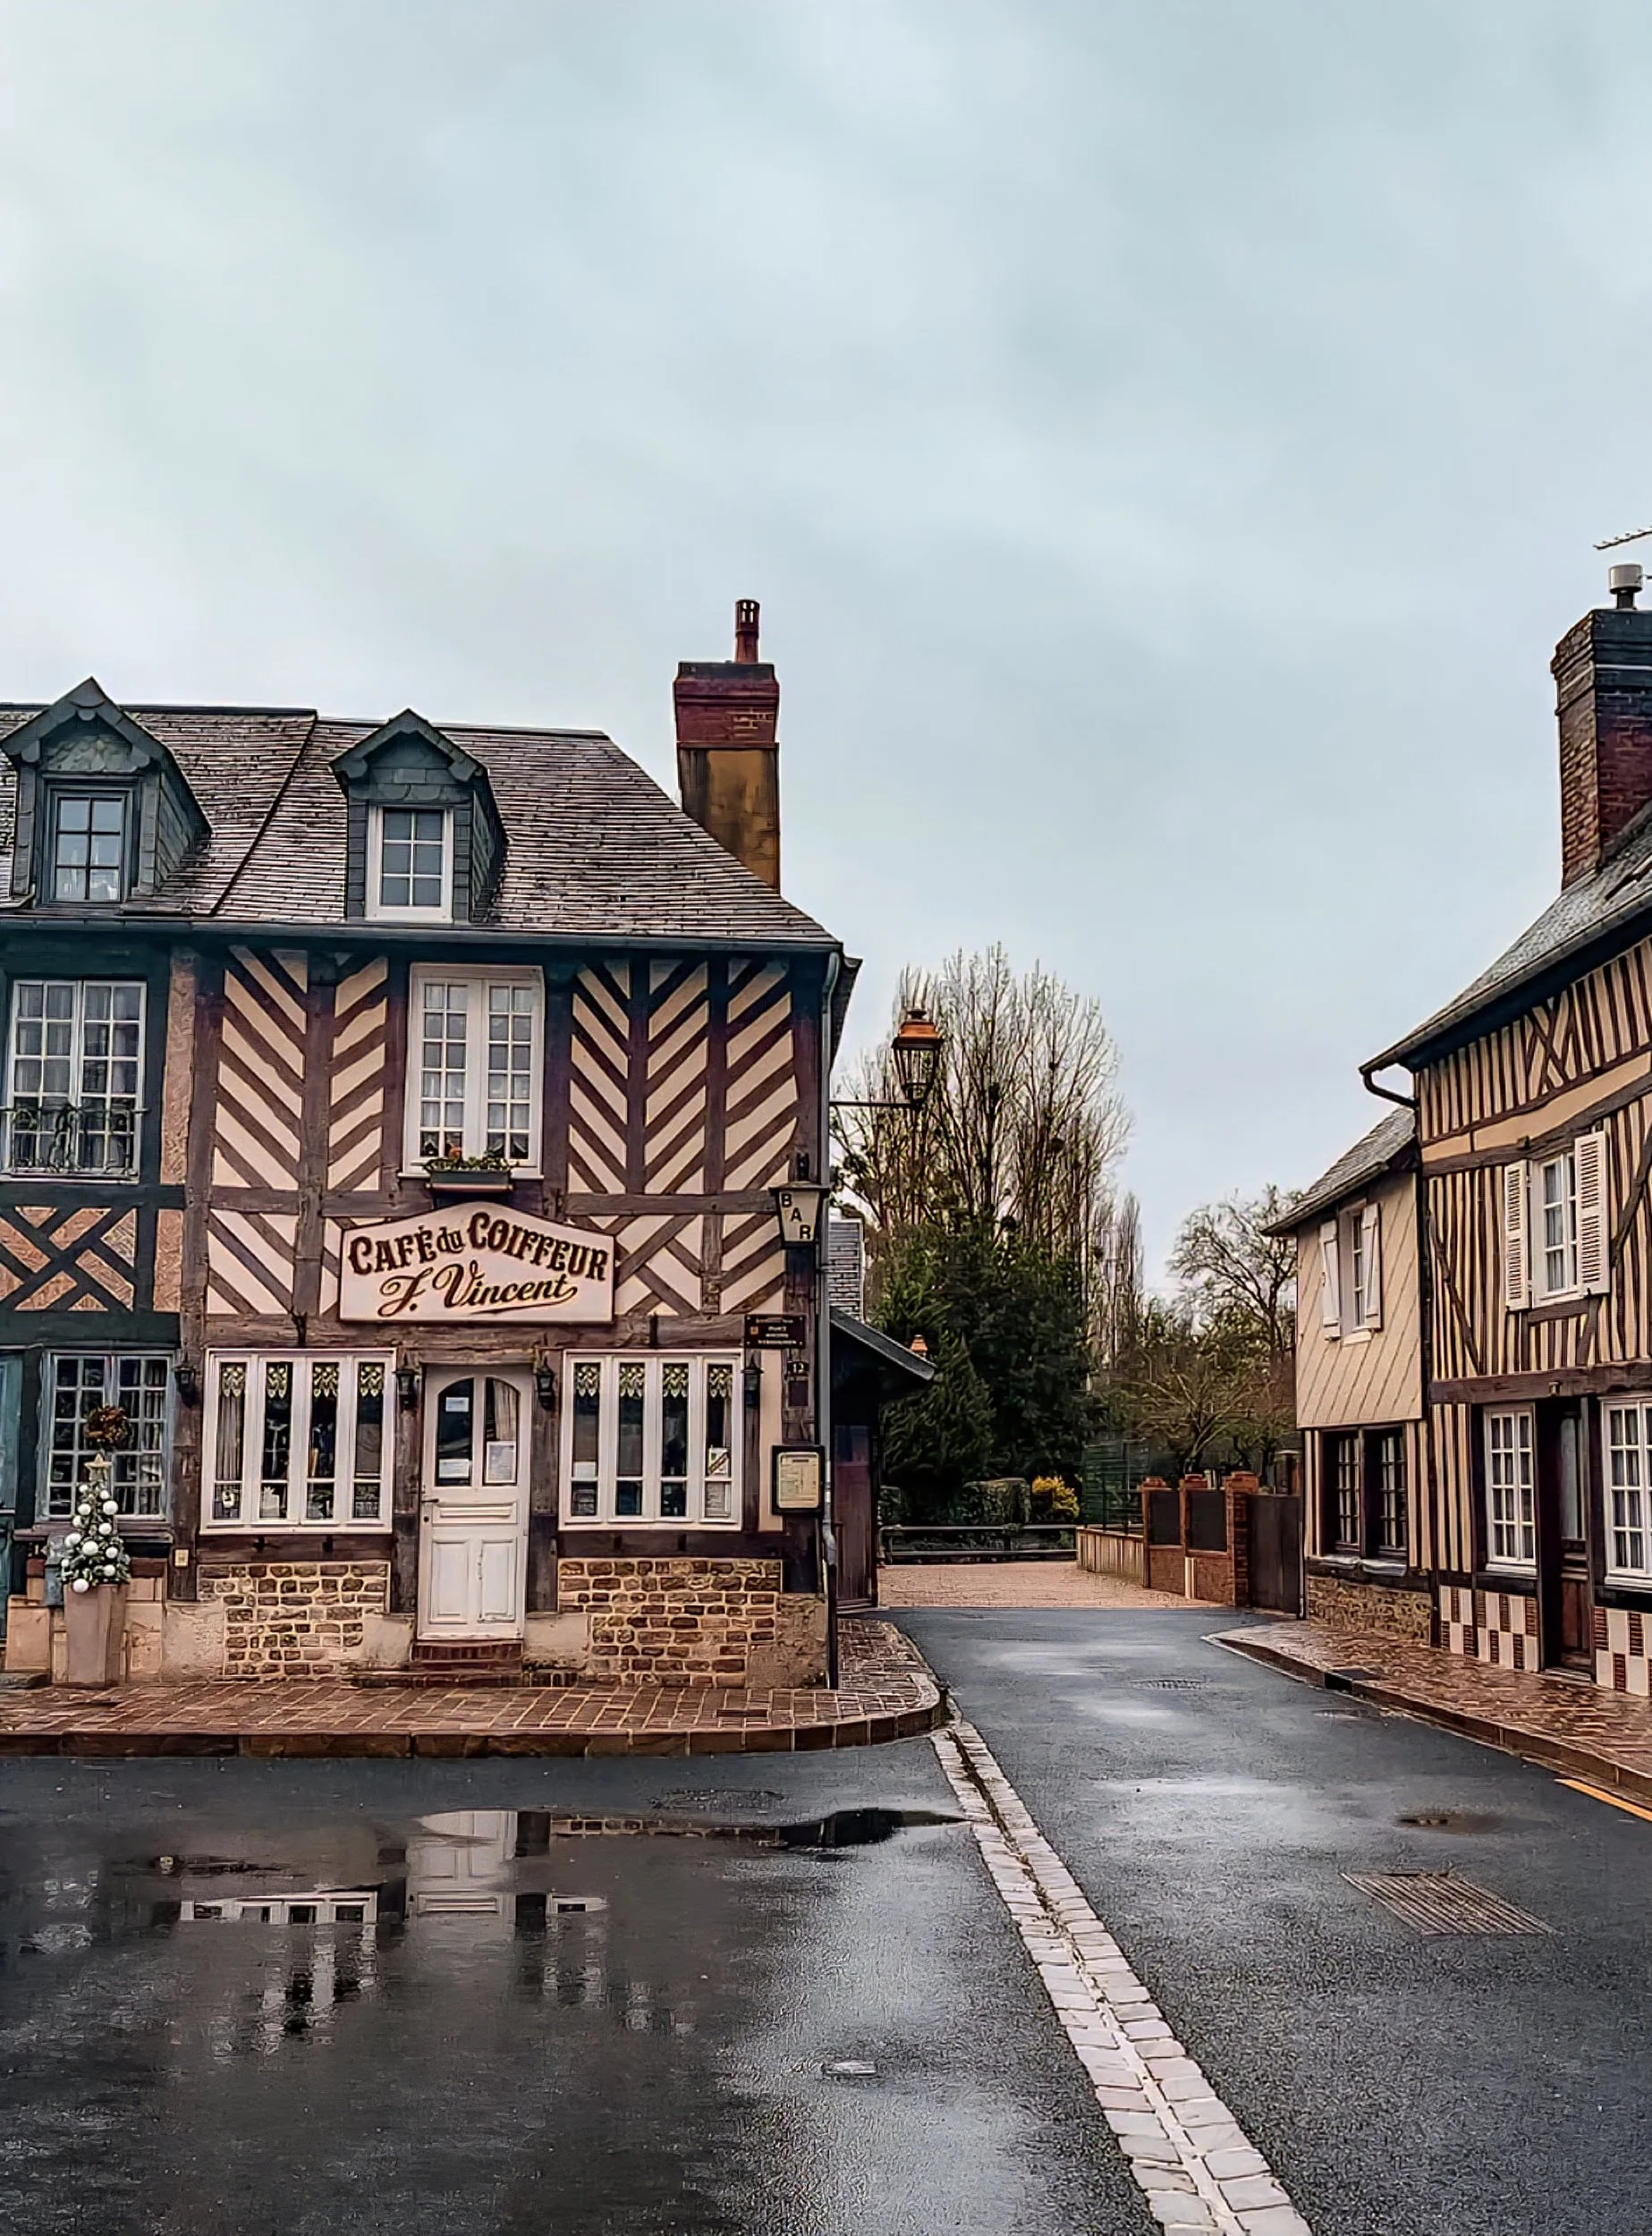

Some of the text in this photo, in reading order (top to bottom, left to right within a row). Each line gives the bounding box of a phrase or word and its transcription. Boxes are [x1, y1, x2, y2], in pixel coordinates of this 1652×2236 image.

[781, 1193, 811, 1240] BAR
[348, 1211, 609, 1281] CAFÉ du COIFFEUR
[432, 1259, 578, 1315] Vincent
